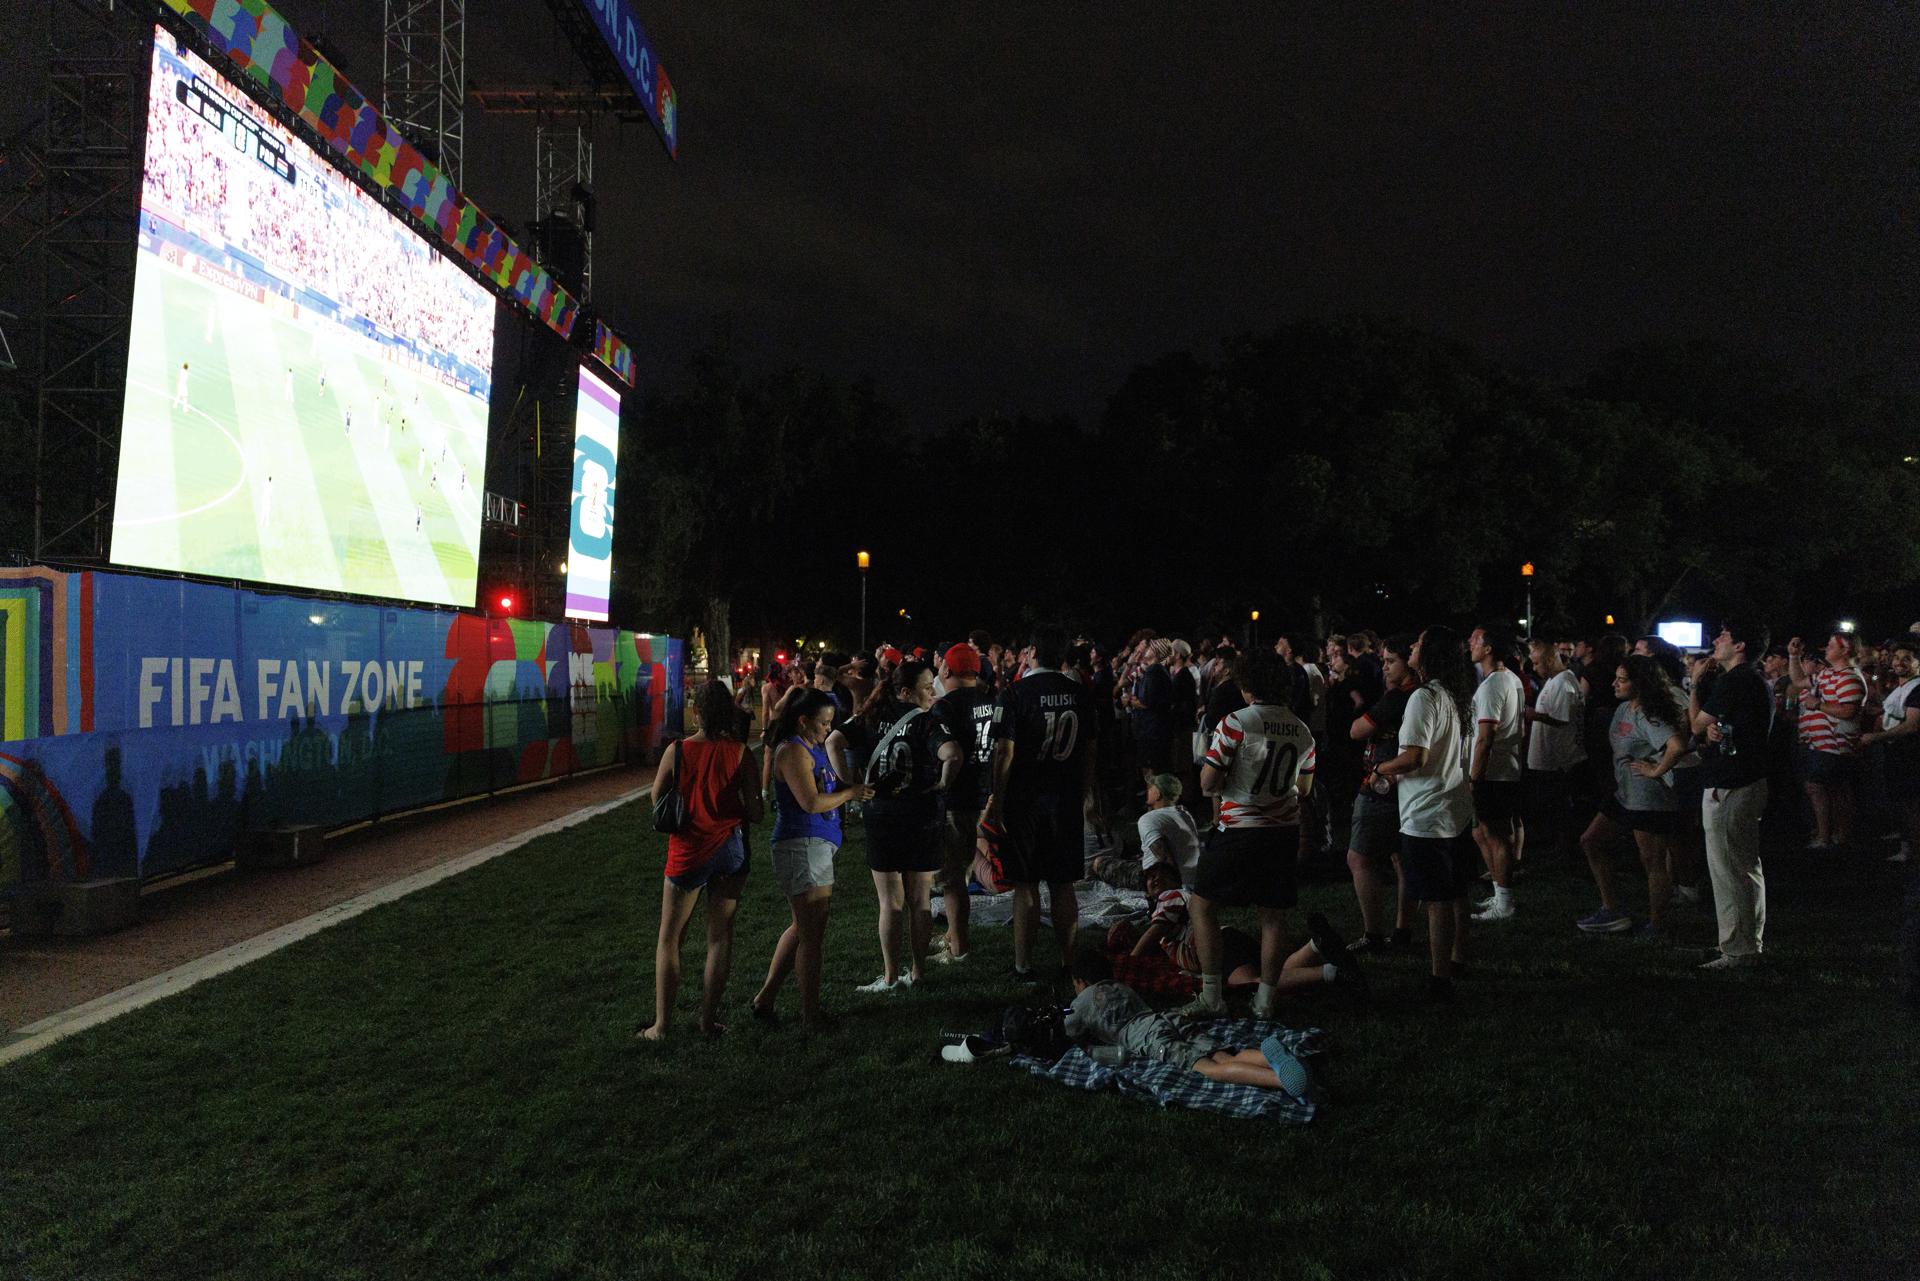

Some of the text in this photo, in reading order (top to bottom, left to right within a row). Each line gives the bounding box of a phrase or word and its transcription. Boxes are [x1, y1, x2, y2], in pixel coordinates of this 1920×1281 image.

[138, 657, 424, 728] FIFA FAN ZONE
[1039, 693, 1079, 708] PULISIC
[1037, 710, 1079, 762] 10
[1263, 721, 1300, 737] PULISIC
[1251, 740, 1297, 797] 10
